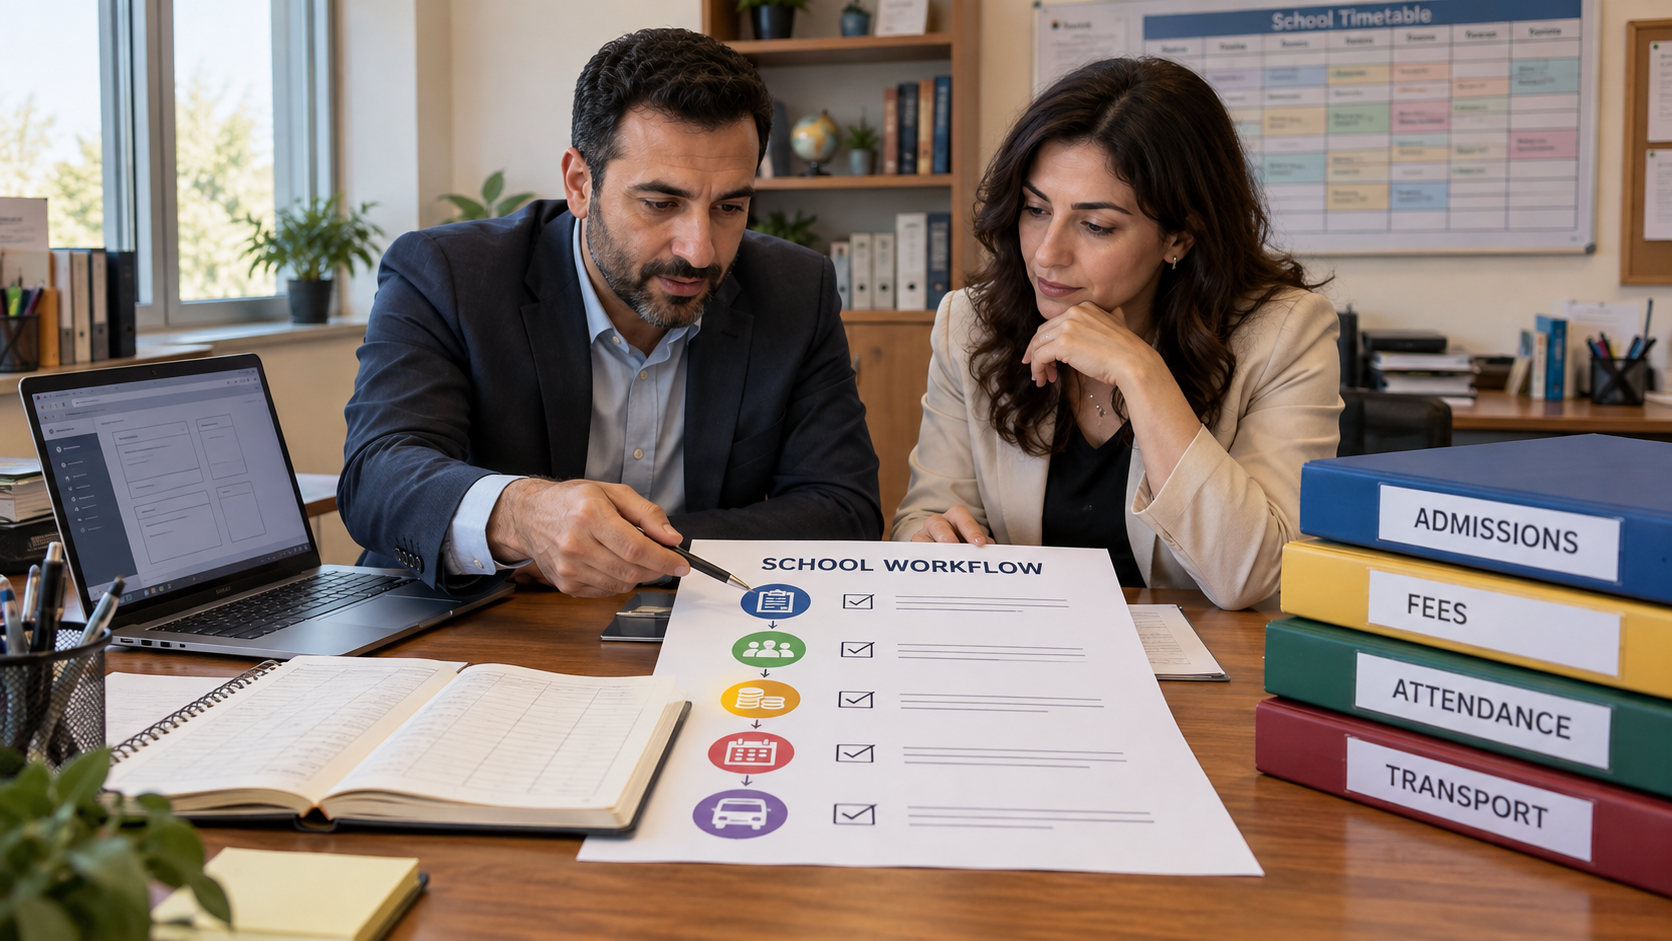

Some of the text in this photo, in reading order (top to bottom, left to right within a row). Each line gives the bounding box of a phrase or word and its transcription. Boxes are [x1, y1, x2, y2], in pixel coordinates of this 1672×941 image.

[1271, 5, 1433, 31] School Timetable
[1414, 507, 1579, 554] ADMISSIONS
[761, 557, 1043, 575] SCHOOL WORKFLOW
[1407, 593, 1468, 625] FEES
[1392, 678, 1572, 740] ATTENDANCE
[1385, 763, 1549, 829] TRANSPORT
